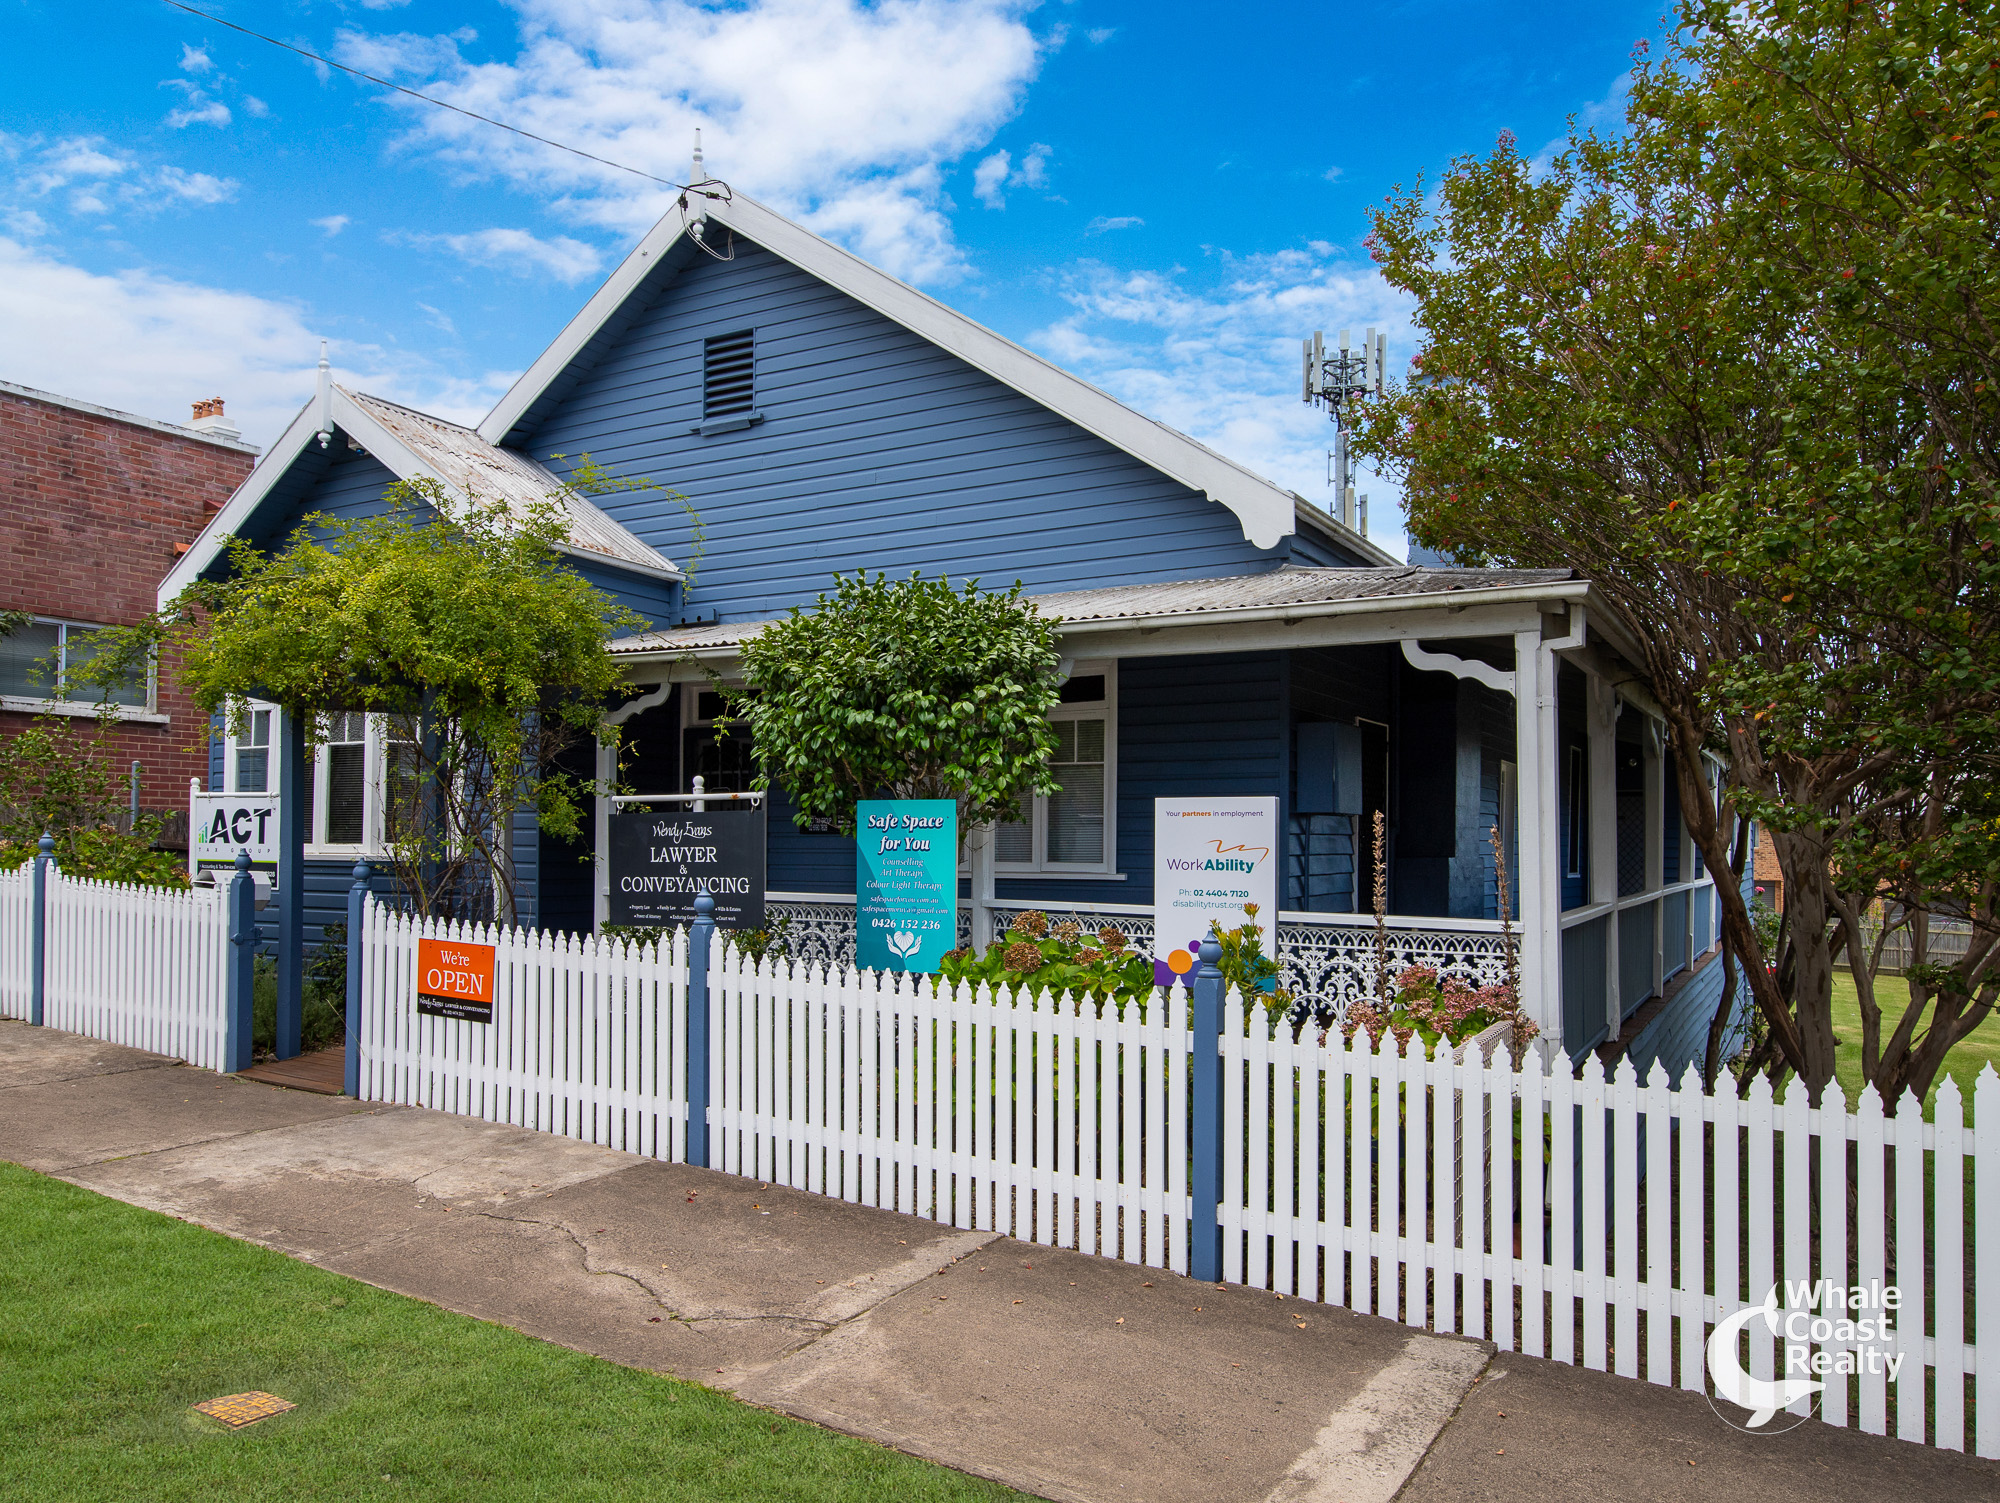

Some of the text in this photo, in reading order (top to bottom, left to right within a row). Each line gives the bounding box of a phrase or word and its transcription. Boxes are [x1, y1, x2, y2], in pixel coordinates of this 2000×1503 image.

[209, 808, 272, 845] ACT
[868, 813, 898, 832] Safe
[901, 814, 944, 833] Space
[653, 821, 712, 844] Wendy Evans
[878, 836, 930, 855] for You
[650, 847, 717, 862] LAWYER
[680, 864, 687, 874] &
[882, 858, 924, 867] Counselling
[1167, 859, 1254, 873] WorkAbility
[895, 869, 924, 878] Therapy
[621, 877, 750, 893] CONVEYANCING
[866, 880, 944, 892] Colour Light Therapy
[872, 918, 941, 929] 0426 152 236
[440, 950, 469, 966] We're
[427, 969, 484, 995] OPEN
